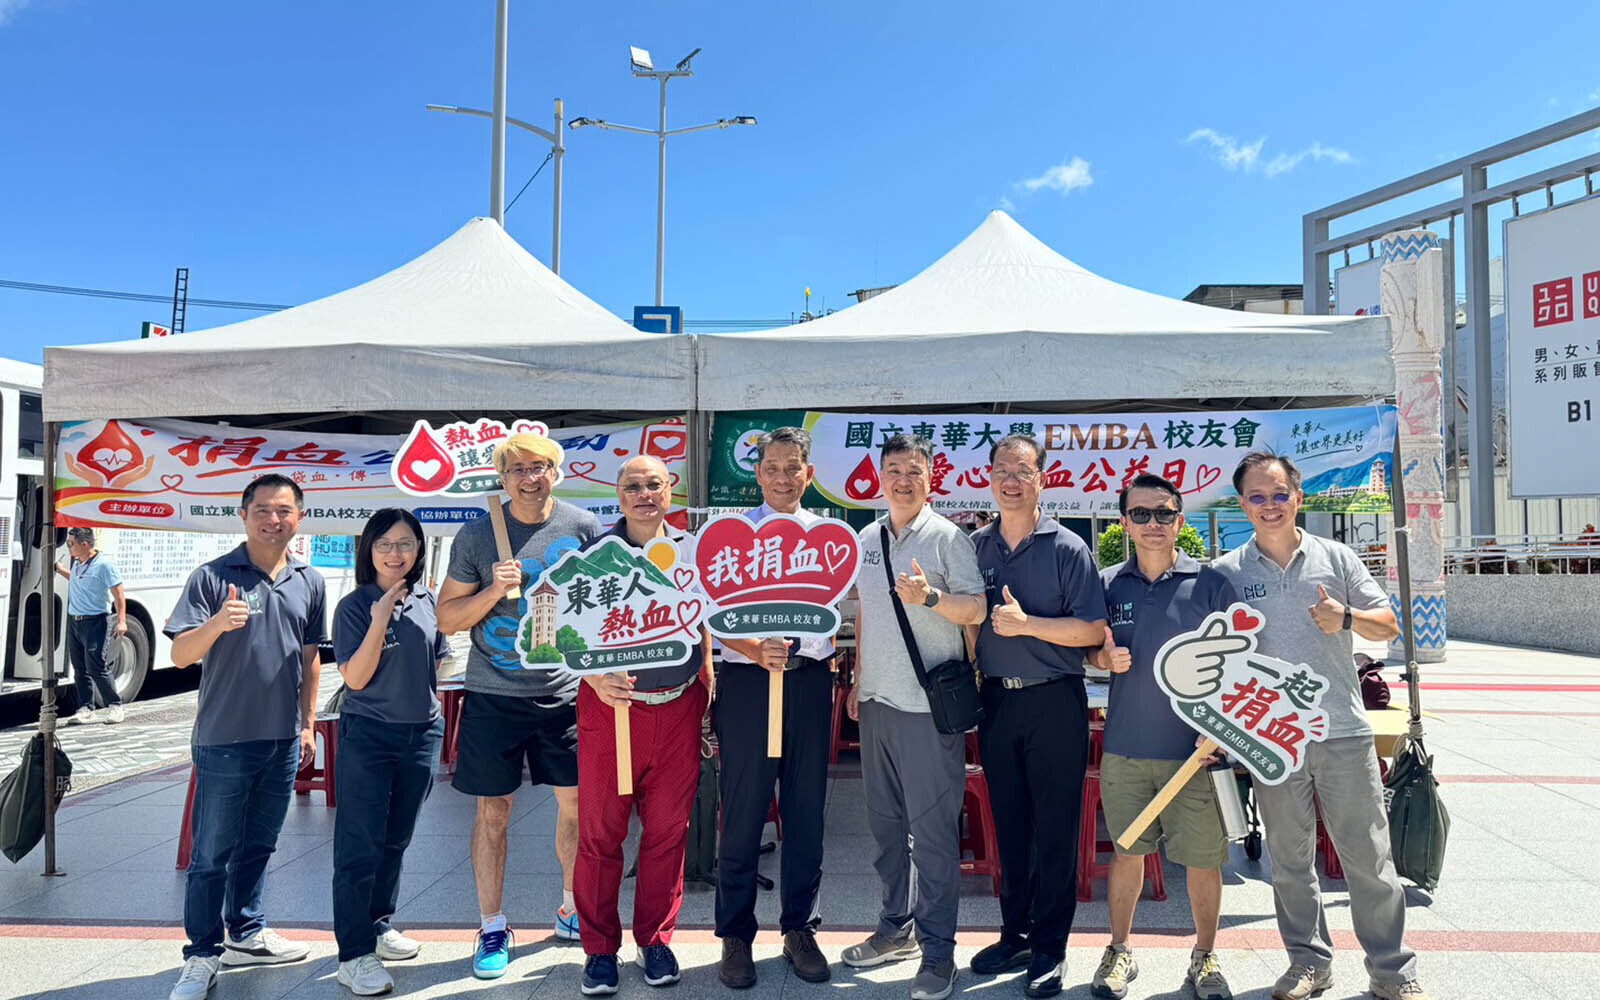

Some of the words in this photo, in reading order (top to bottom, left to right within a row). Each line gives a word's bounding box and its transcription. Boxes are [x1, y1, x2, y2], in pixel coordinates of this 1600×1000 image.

[1567, 399, 1591, 423] B1
[444, 422, 507, 450] 熱血
[190, 505, 240, 517] 國立東
[706, 535, 824, 588] 我捐血
[562, 572, 656, 616] 東華人
[597, 600, 676, 643] 熱血
[762, 614, 791, 624] EMBA
[793, 613, 822, 625] 校友會
[617, 650, 645, 662] EMBA
[647, 646, 674, 659] 校友會
[1246, 659, 1324, 711] 一起
[1221, 676, 1306, 768] 捐血
[1223, 728, 1251, 753] EMBA
